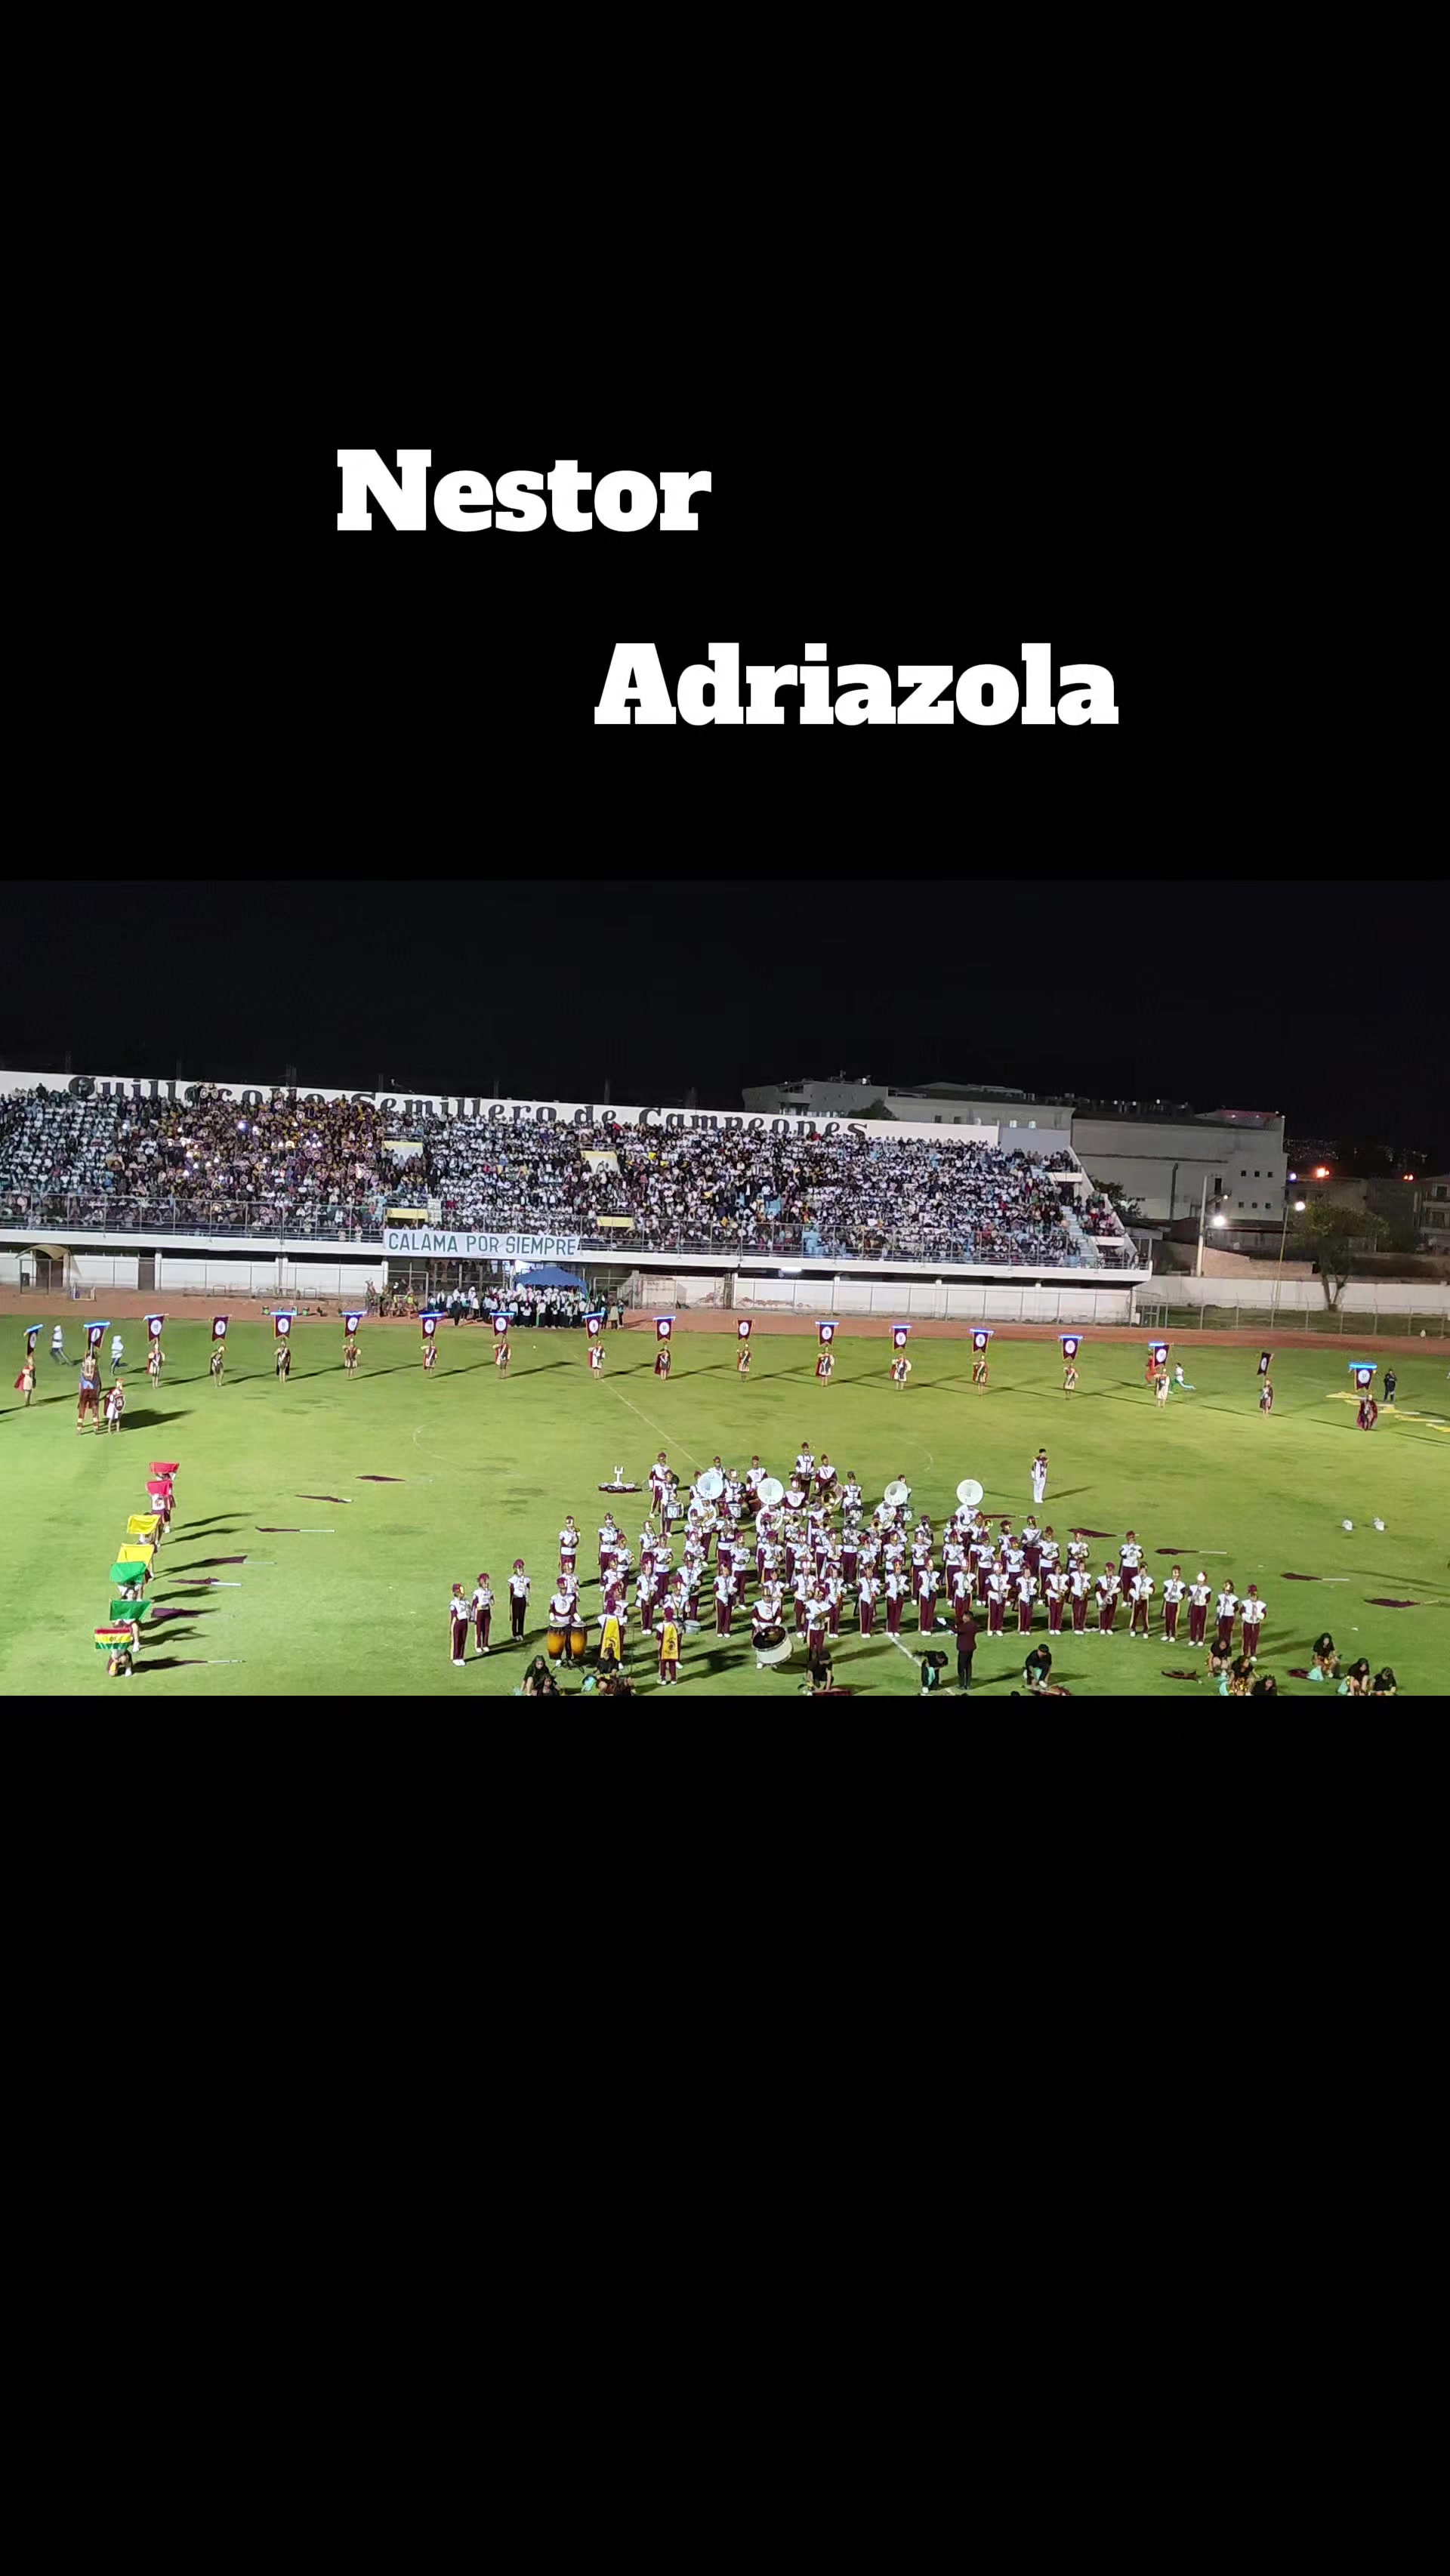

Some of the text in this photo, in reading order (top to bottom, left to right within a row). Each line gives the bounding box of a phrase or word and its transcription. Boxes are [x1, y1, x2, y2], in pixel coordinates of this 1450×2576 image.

[574, 1105, 616, 1125] de
[388, 1232, 576, 1256] CALAMA POR SIEMPRE
